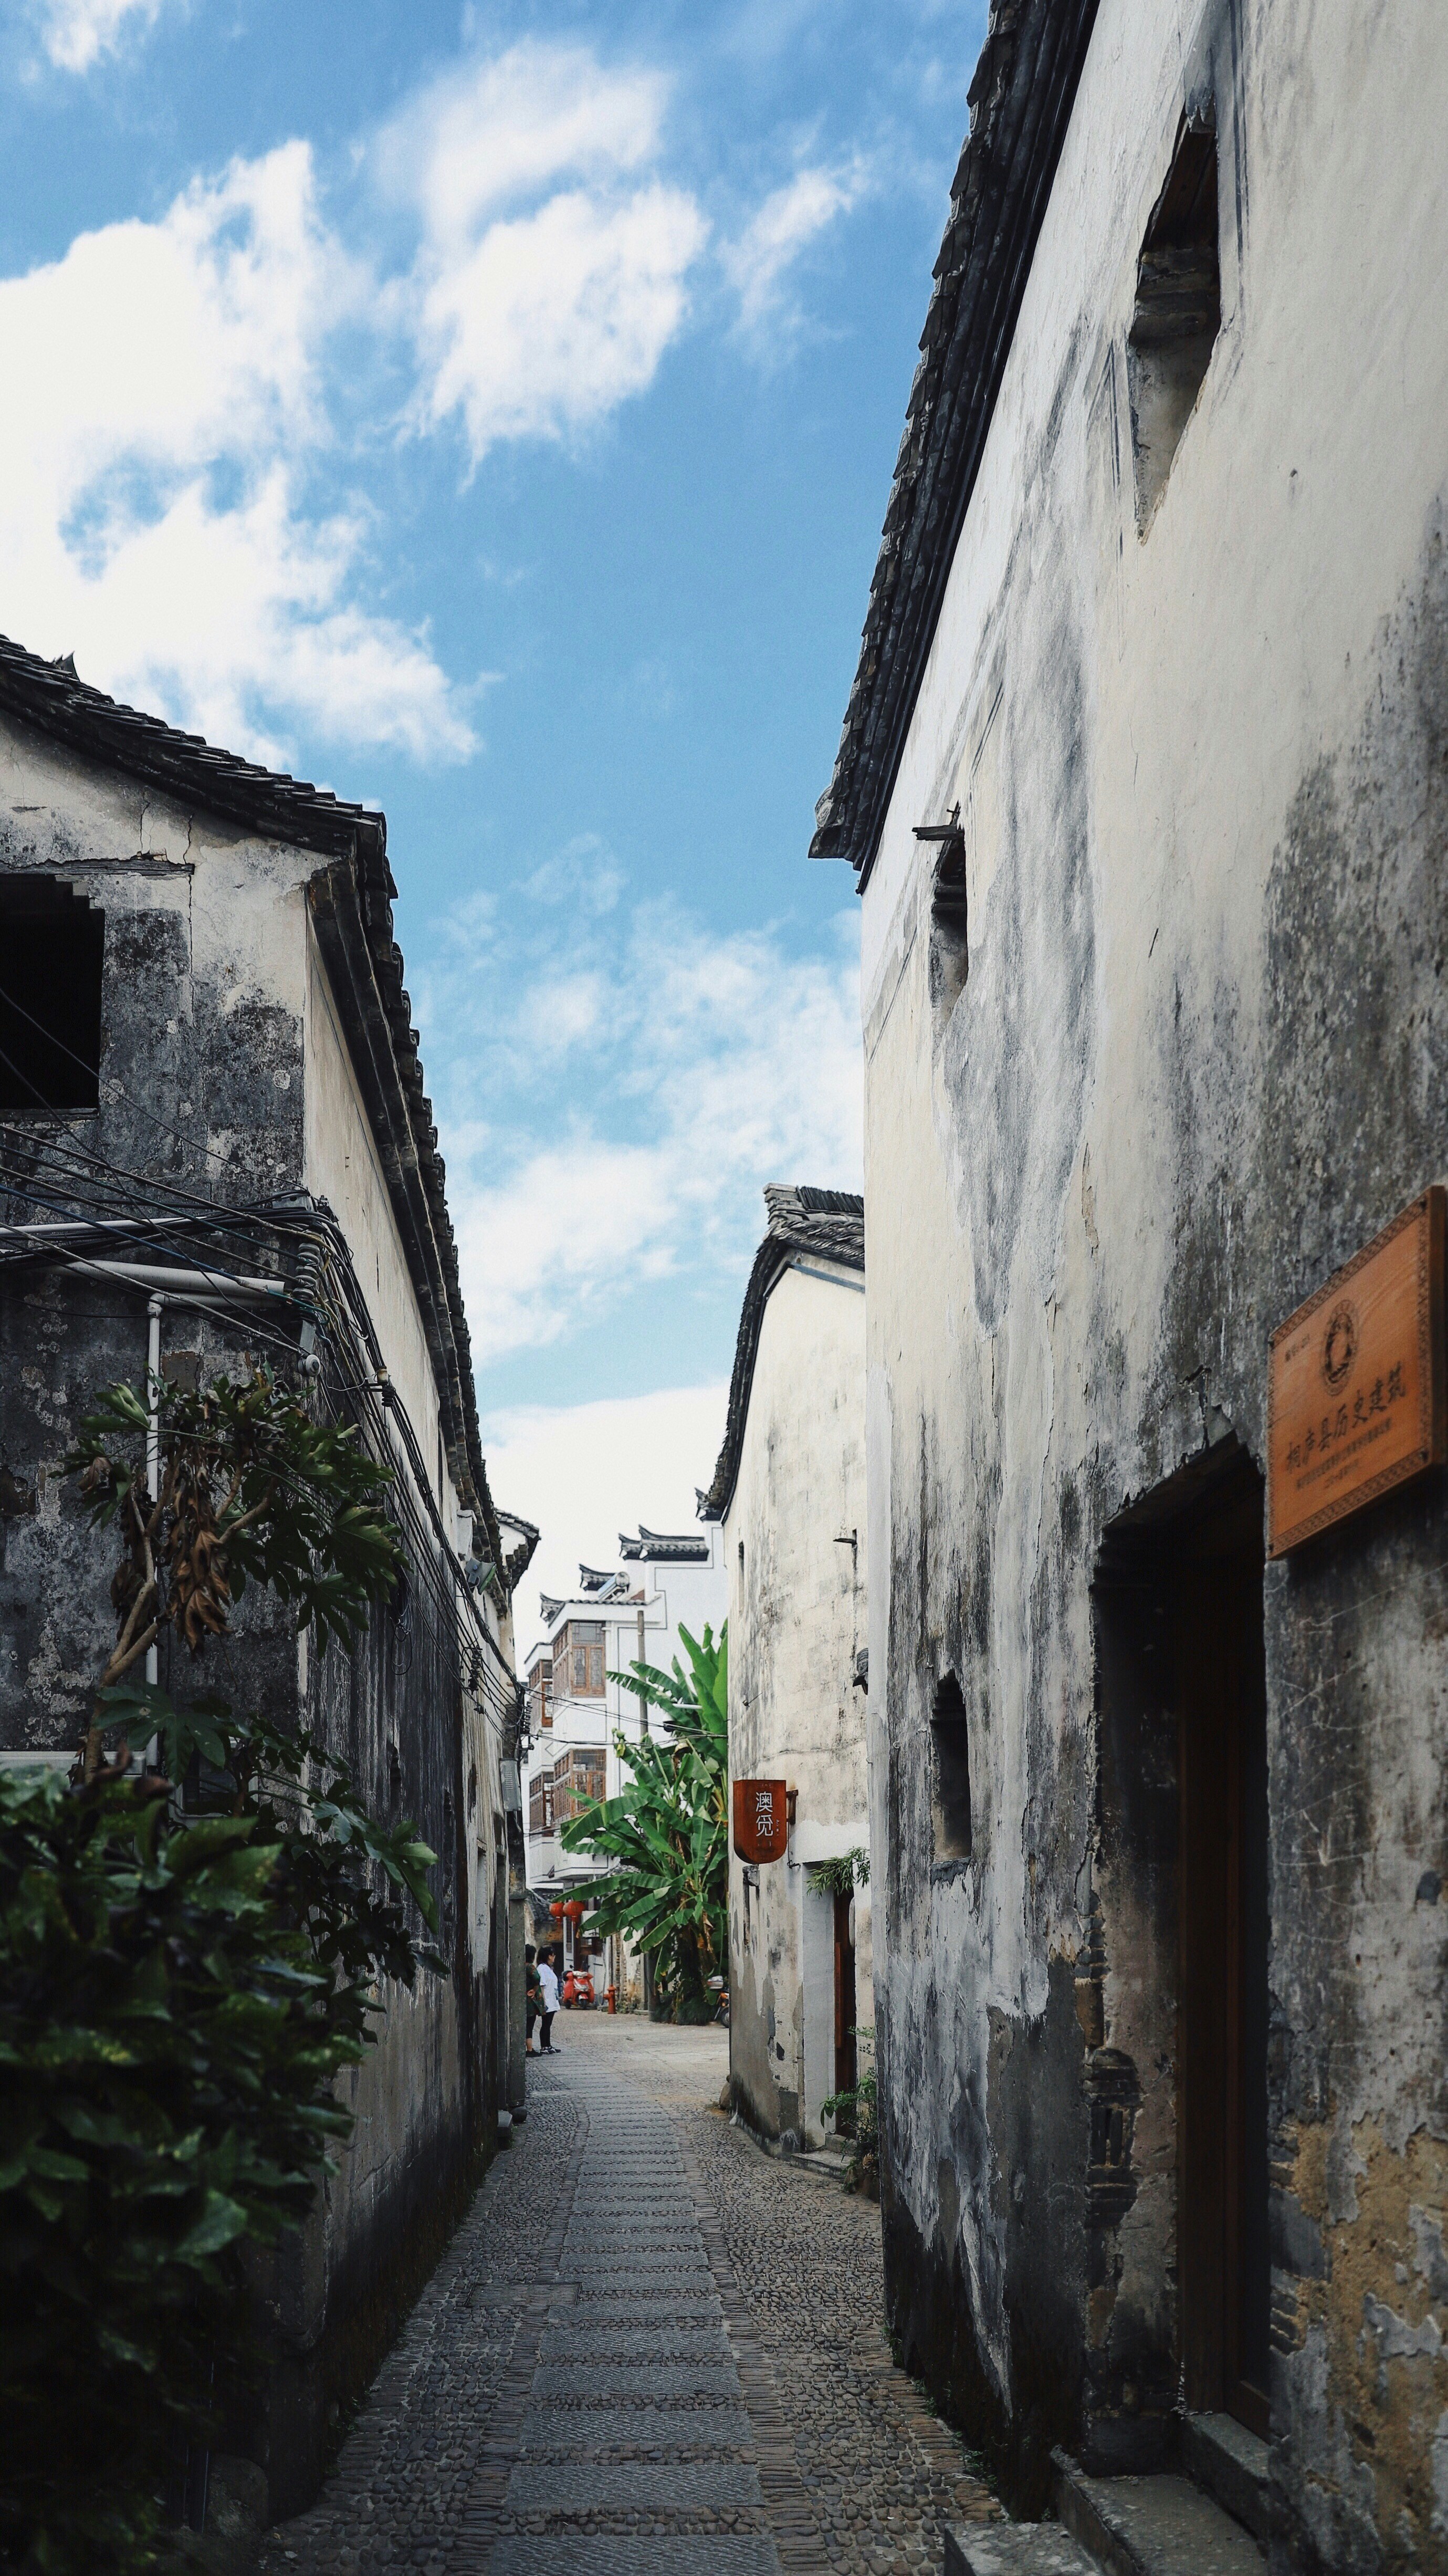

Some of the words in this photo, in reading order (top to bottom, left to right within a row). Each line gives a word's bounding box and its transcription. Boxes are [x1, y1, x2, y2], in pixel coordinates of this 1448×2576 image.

[1287, 1361, 1407, 1474] 桐庐县历史建筑
[756, 1791, 773, 1837] 澳觅
